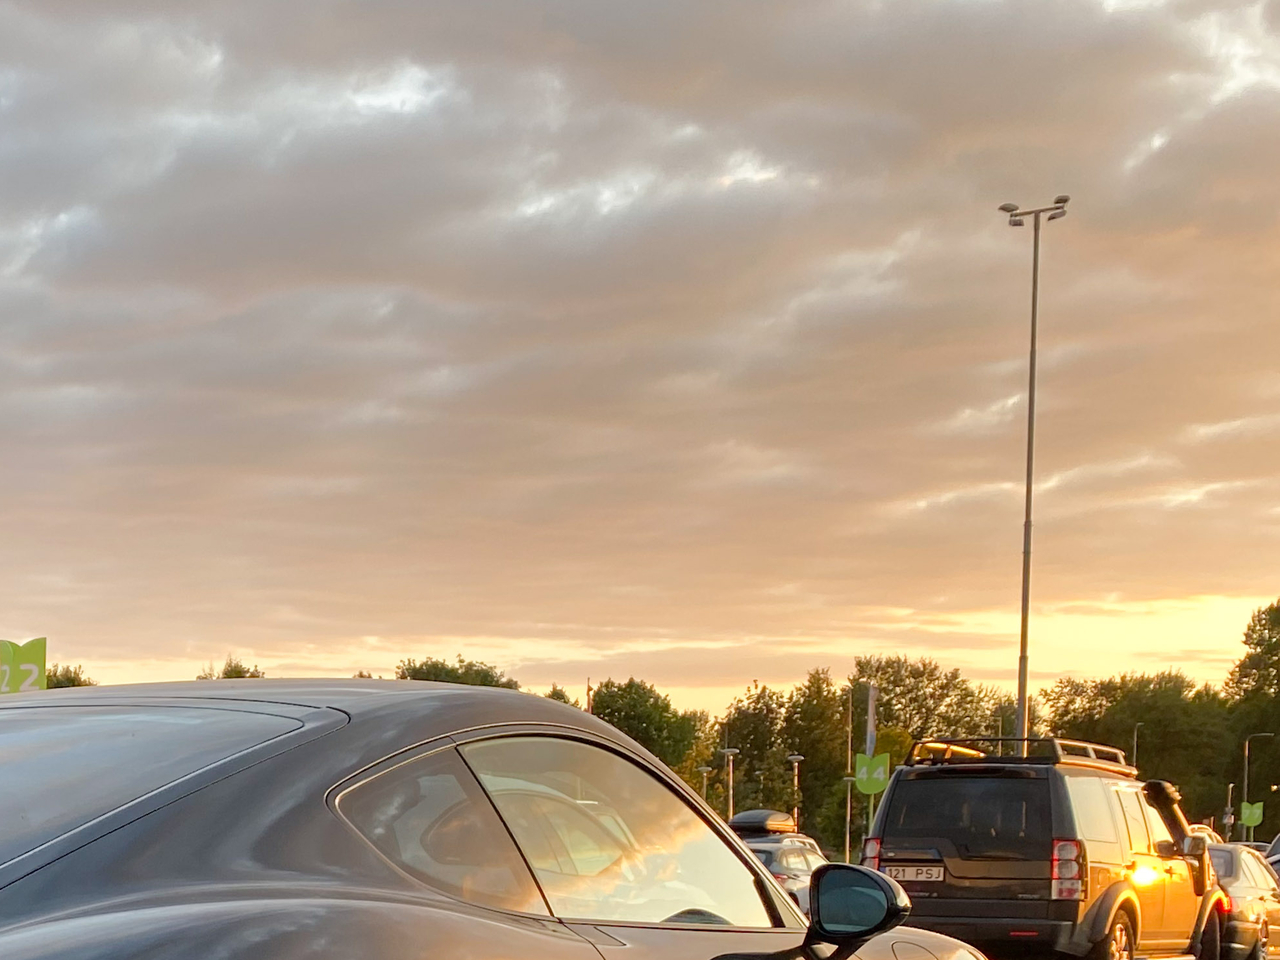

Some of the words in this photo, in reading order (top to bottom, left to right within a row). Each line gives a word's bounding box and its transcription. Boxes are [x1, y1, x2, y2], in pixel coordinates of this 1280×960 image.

[19, 663, 40, 692] 2
[888, 868, 906, 879] 121
[915, 869, 942, 880] PSJ
